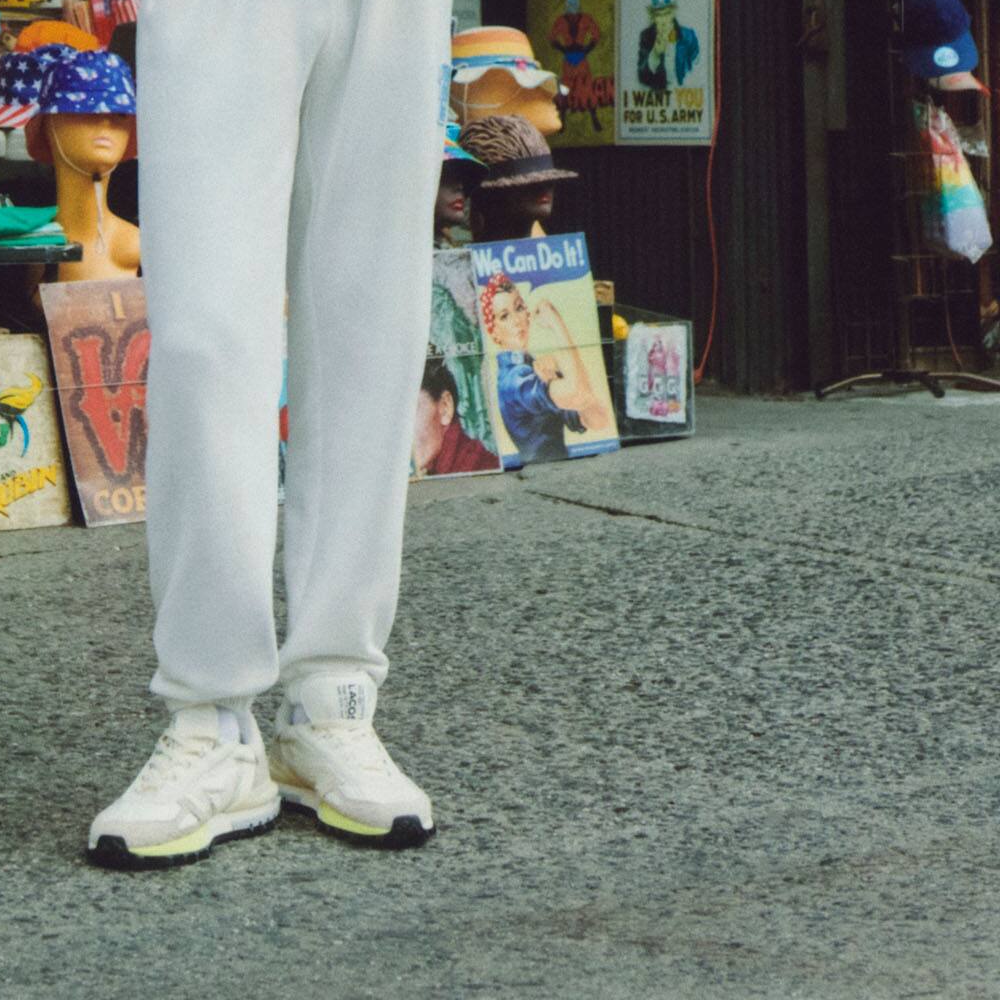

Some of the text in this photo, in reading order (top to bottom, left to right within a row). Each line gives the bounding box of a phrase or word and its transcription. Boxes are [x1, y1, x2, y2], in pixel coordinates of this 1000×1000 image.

[632, 89, 672, 107] WANT
[674, 87, 704, 108] YOU
[623, 110, 643, 123] FOR
[671, 108, 704, 123] ARMY
[473, 238, 586, 277] We Can Do It!
[1, 469, 17, 481] AND
